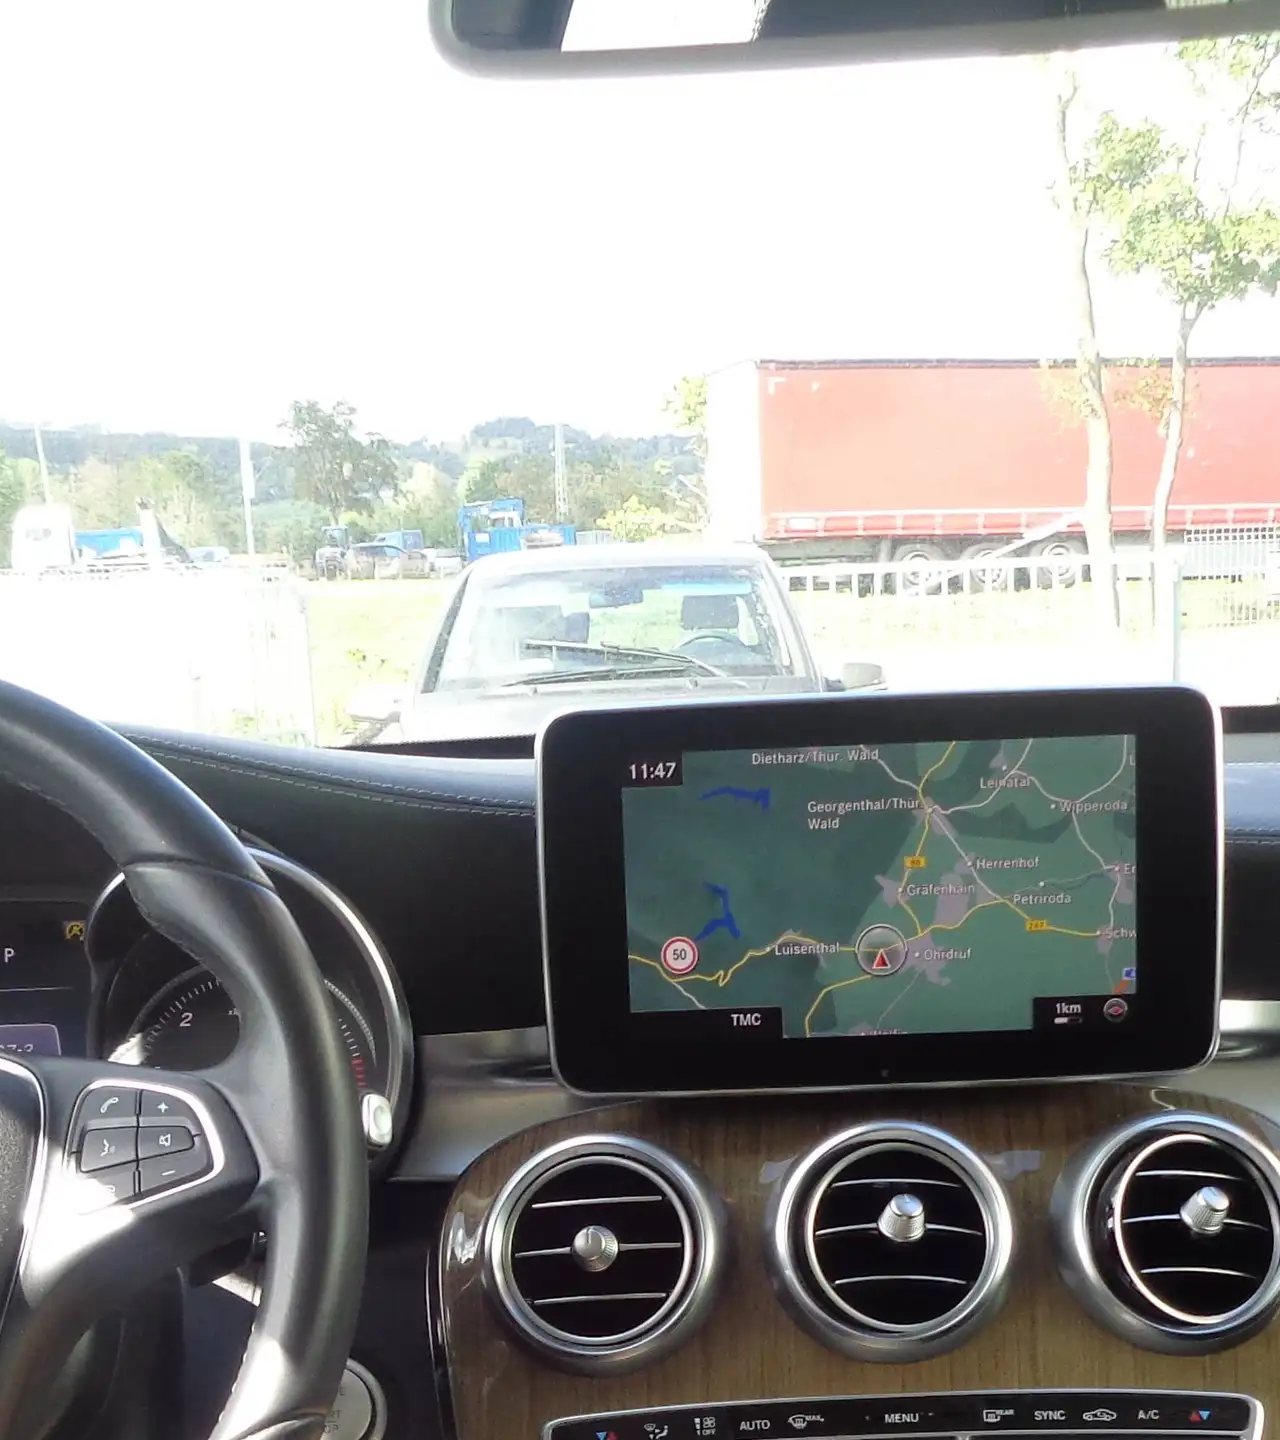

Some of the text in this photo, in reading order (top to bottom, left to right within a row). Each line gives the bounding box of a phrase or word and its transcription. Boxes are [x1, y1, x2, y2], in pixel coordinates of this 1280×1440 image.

[846, 747, 880, 761] Wald
[629, 761, 676, 781] 11:47
[980, 776, 1031, 789] Leinatal
[1059, 800, 1128, 814] Wipperoda
[807, 816, 840, 830] Wald
[976, 856, 1039, 870] Herrenhof
[907, 883, 975, 896] Gräfenhain
[1013, 893, 1071, 905] Petriroda
[4, 948, 15, 963] P
[672, 948, 688, 961] 50
[774, 942, 841, 956] Luisenthal
[923, 947, 971, 961] Ohrdruf
[1055, 1002, 1082, 1015] 1km
[179, 1012, 193, 1027] 2
[731, 1012, 762, 1027] TMC
[884, 1413, 919, 1424] MENU
[1034, 1409, 1066, 1421] SYNC
[1137, 1409, 1160, 1420] A/C
[739, 1419, 771, 1431] AUTO
